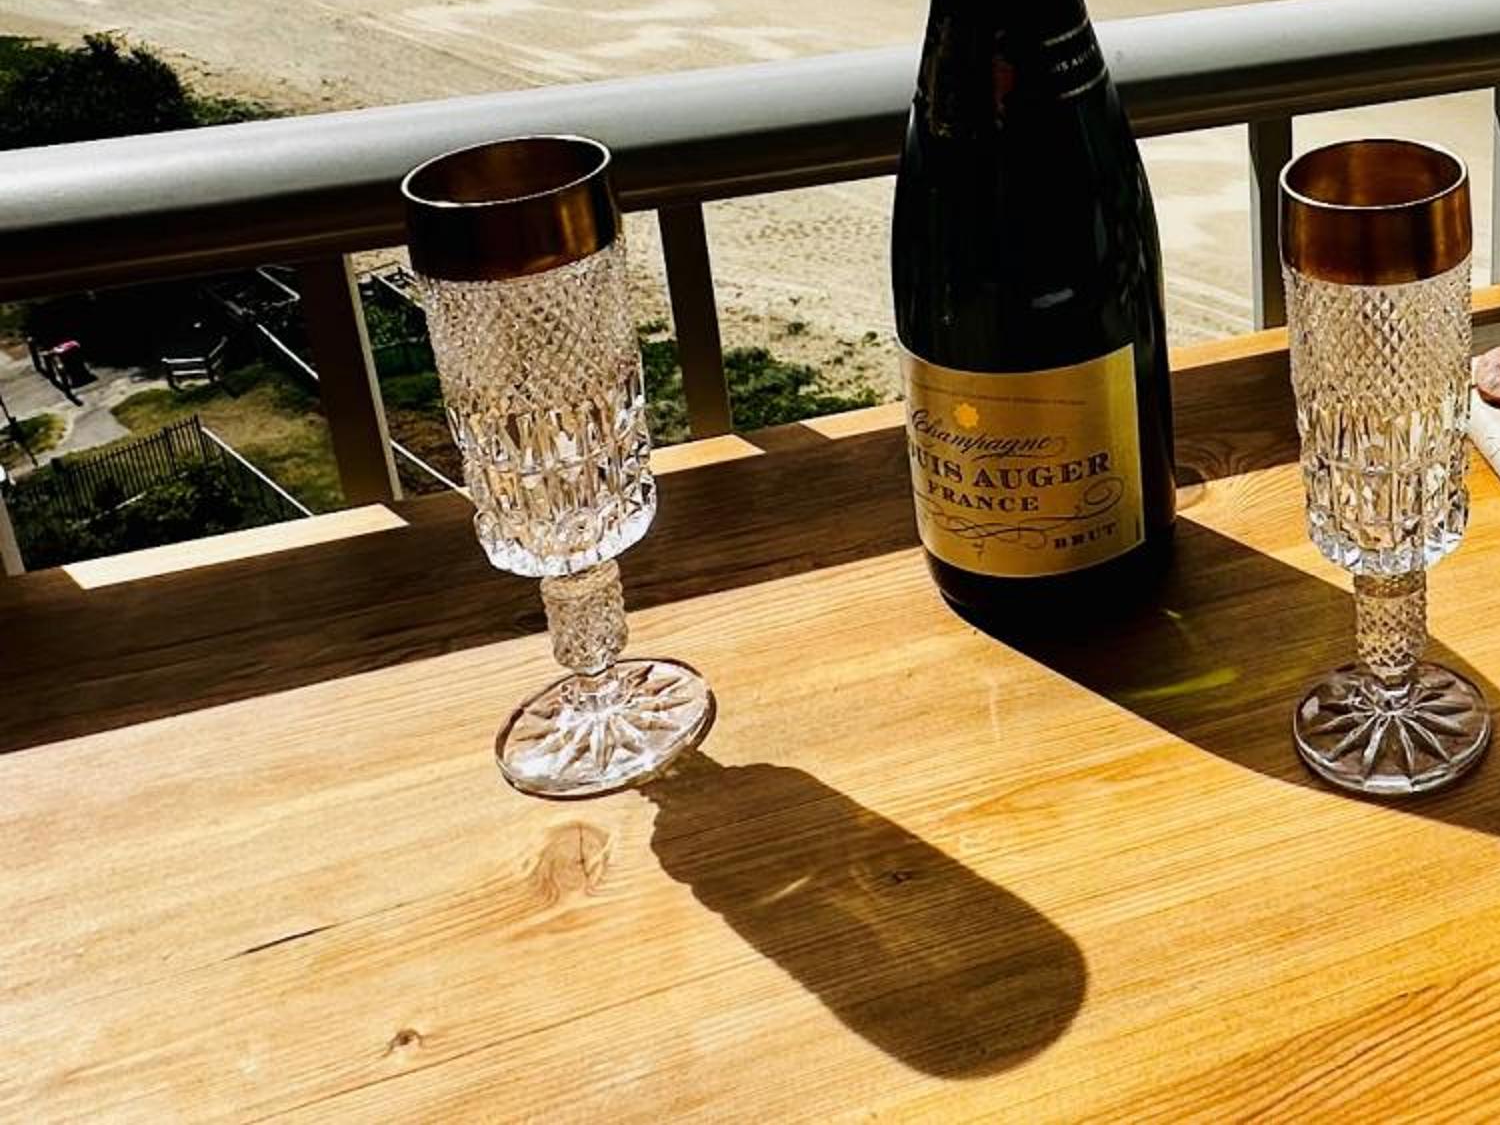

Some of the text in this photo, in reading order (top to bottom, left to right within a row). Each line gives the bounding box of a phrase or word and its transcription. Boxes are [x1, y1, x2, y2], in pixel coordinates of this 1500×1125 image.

[911, 409, 1051, 454] Champagne
[973, 452, 1110, 489] AUGER
[927, 479, 1038, 512] FRANCE
[1054, 522, 1117, 549] BRUT
